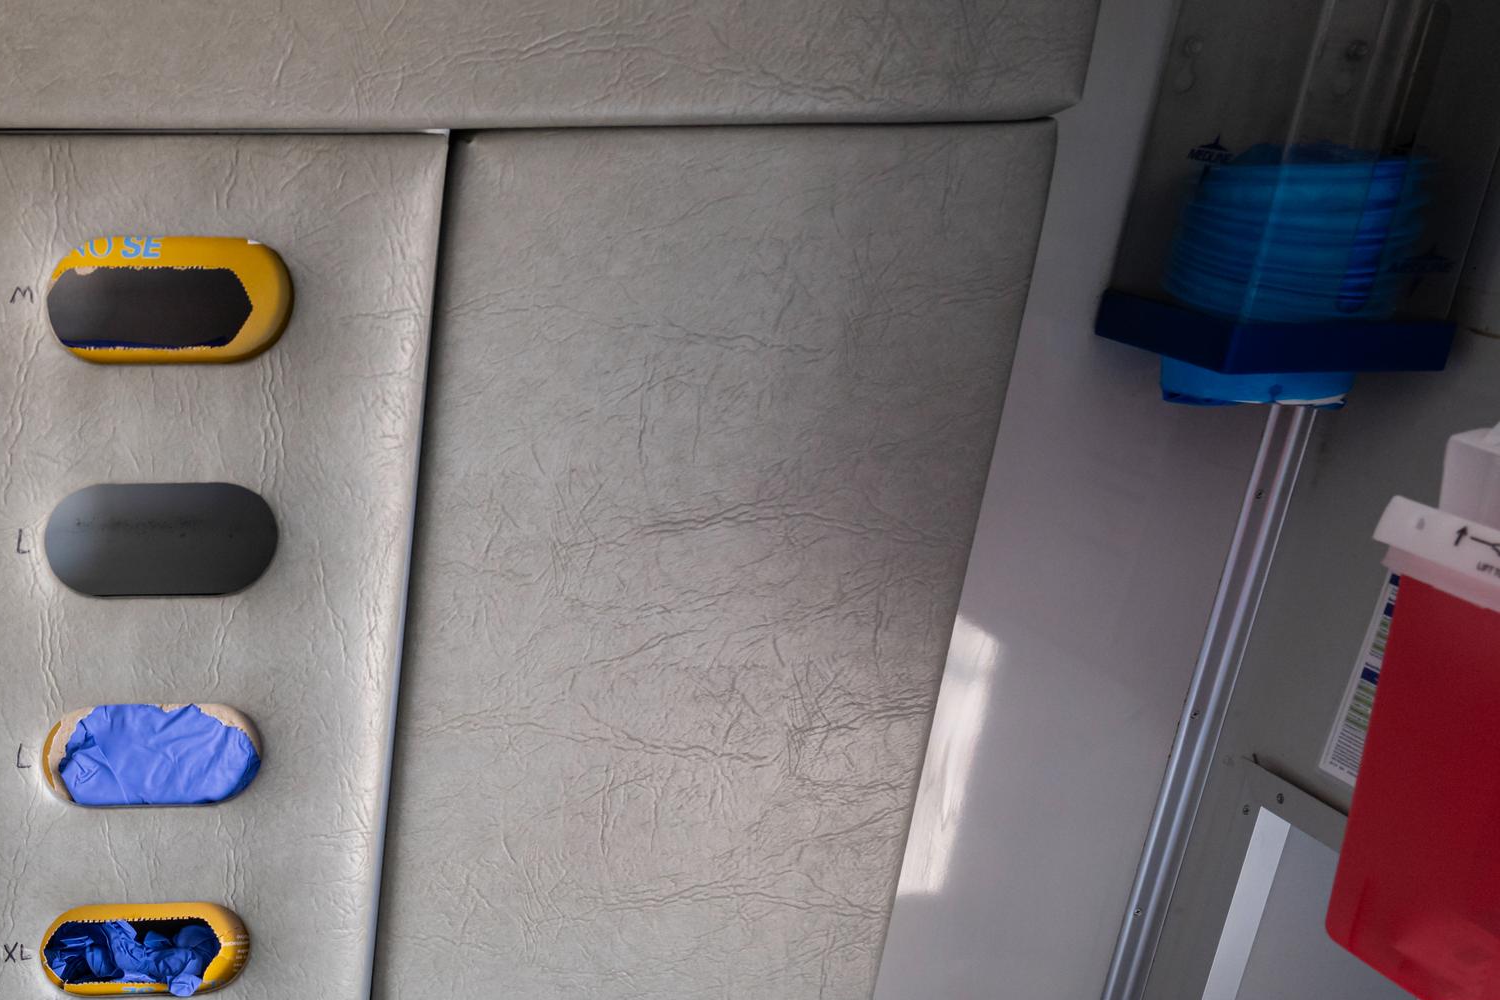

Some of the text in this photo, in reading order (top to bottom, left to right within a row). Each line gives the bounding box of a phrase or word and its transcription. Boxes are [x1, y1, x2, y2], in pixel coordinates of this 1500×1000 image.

[121, 234, 162, 258] SE
[10, 286, 34, 304] M
[16, 528, 31, 554] L
[17, 743, 32, 770] L
[4, 942, 32, 963] XL
